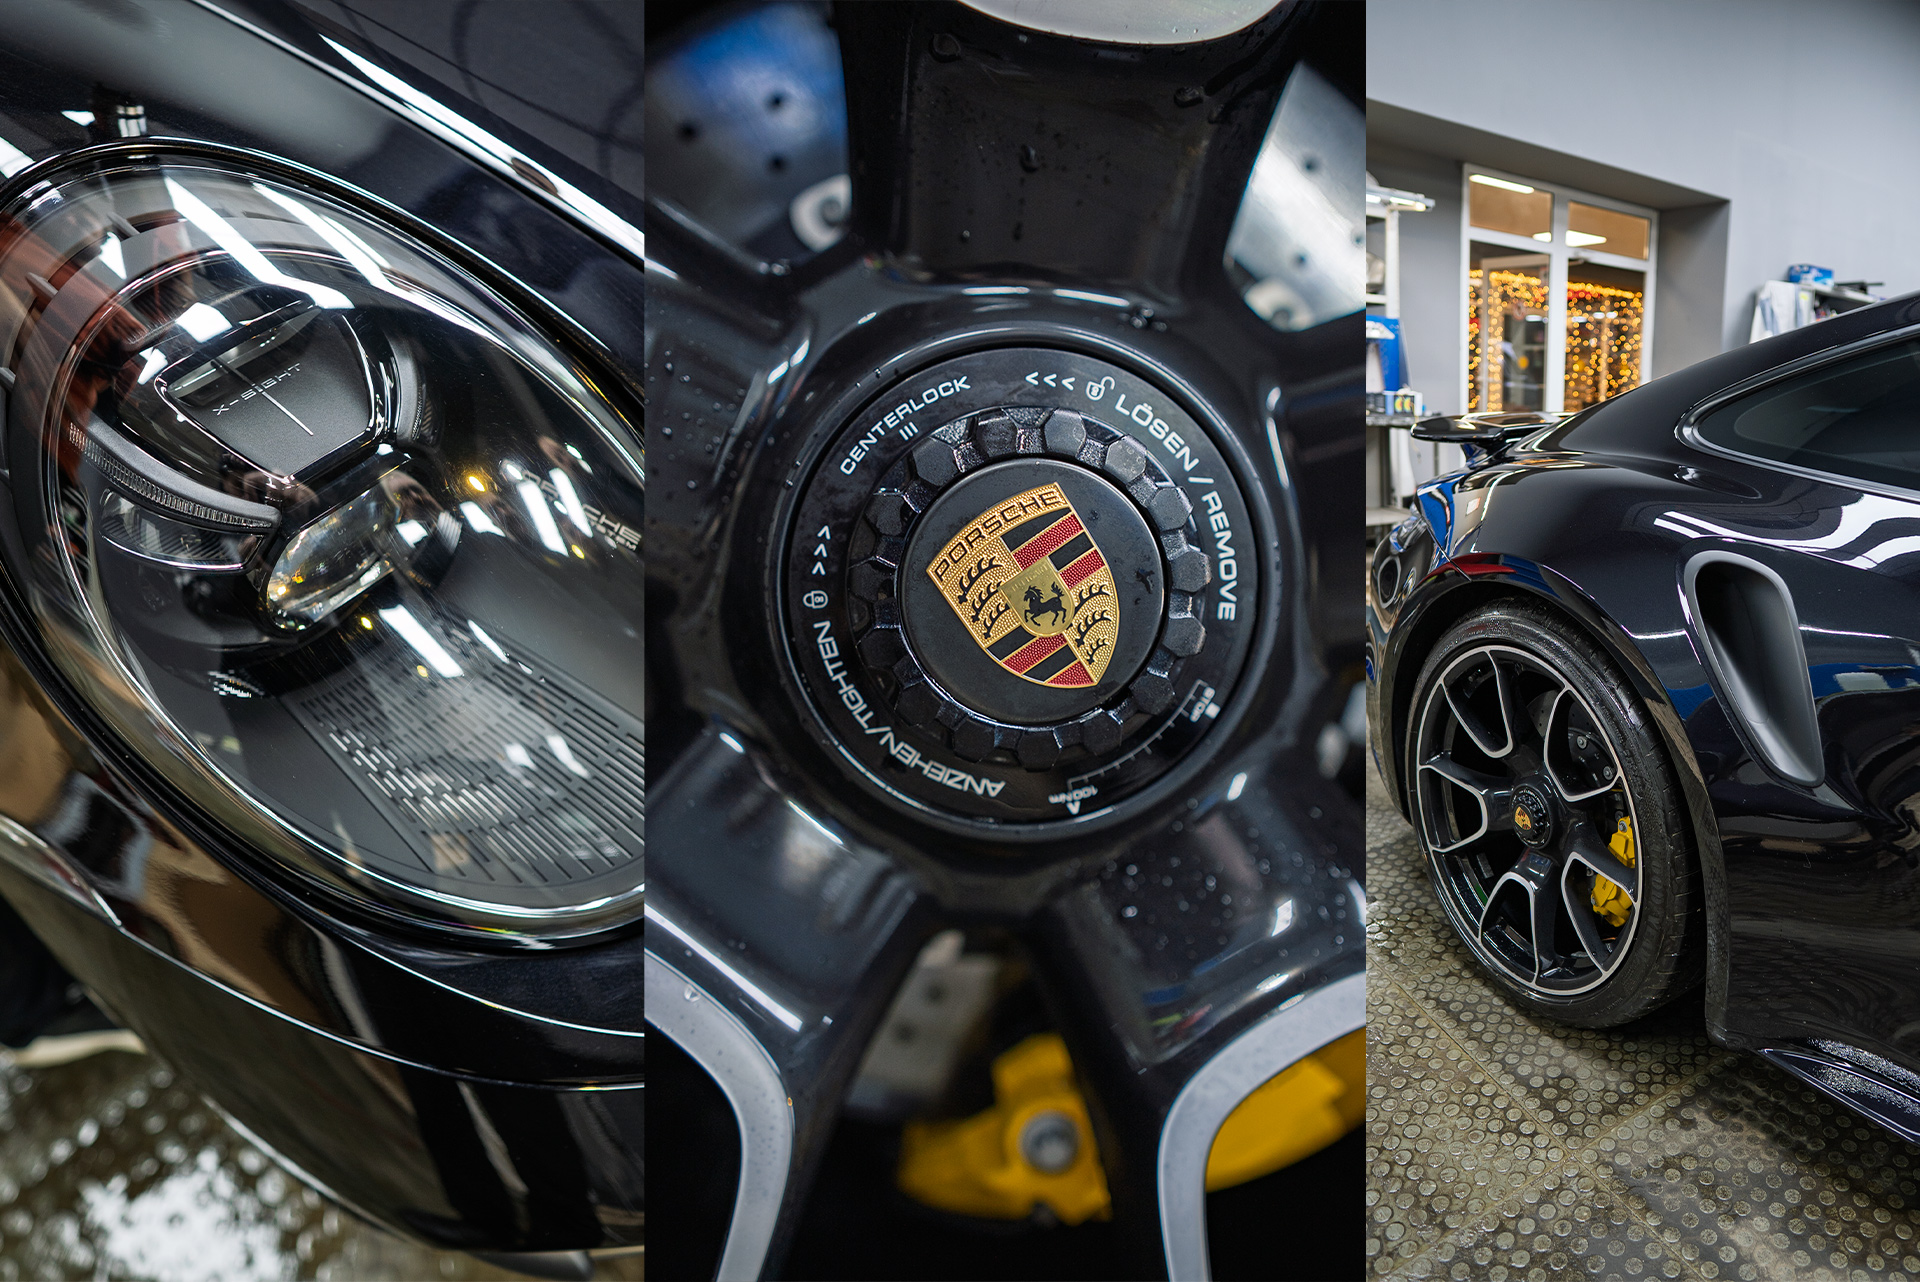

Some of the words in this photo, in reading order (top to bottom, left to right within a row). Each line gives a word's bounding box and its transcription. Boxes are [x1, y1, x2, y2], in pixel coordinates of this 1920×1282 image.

[212, 362, 300, 416] X-SIGHT
[839, 375, 971, 476] CENTERLOCK
[503, 461, 642, 545] ORCHE
[587, 517, 637, 551] YSTEM
[933, 490, 1061, 582] PORSCHE
[1114, 394, 1200, 472] LÖSEN
[1201, 490, 1238, 621] REMOVE
